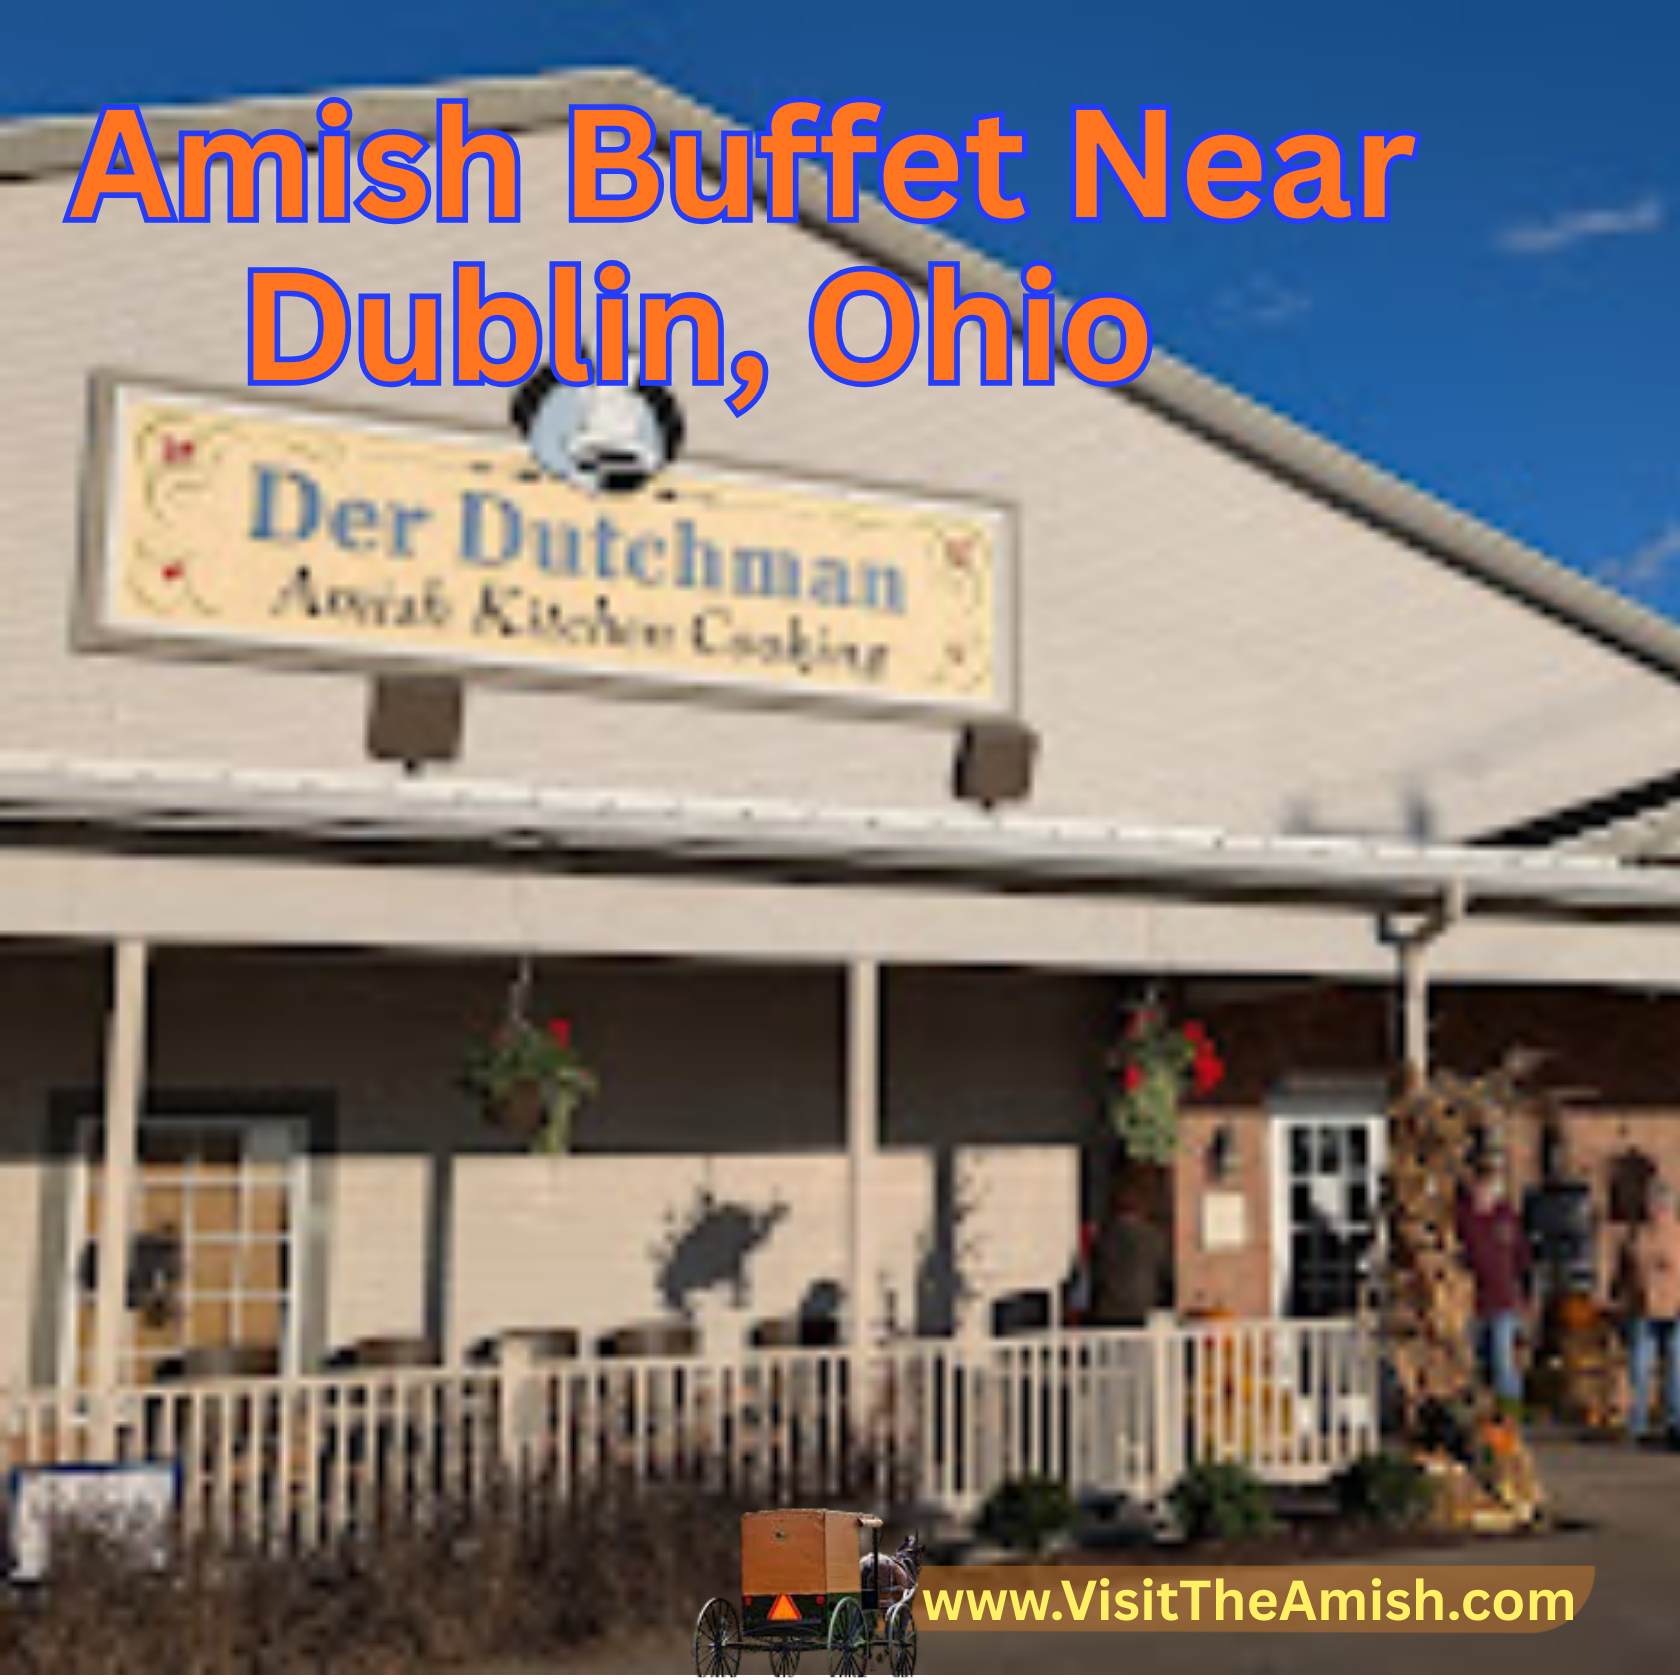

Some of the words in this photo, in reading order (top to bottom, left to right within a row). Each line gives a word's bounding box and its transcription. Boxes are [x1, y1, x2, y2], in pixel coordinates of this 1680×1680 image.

[247, 462, 431, 560] Der
[457, 489, 908, 615] Dutchman
[471, 587, 677, 655] Kitchen
[690, 606, 890, 683] Cooking
